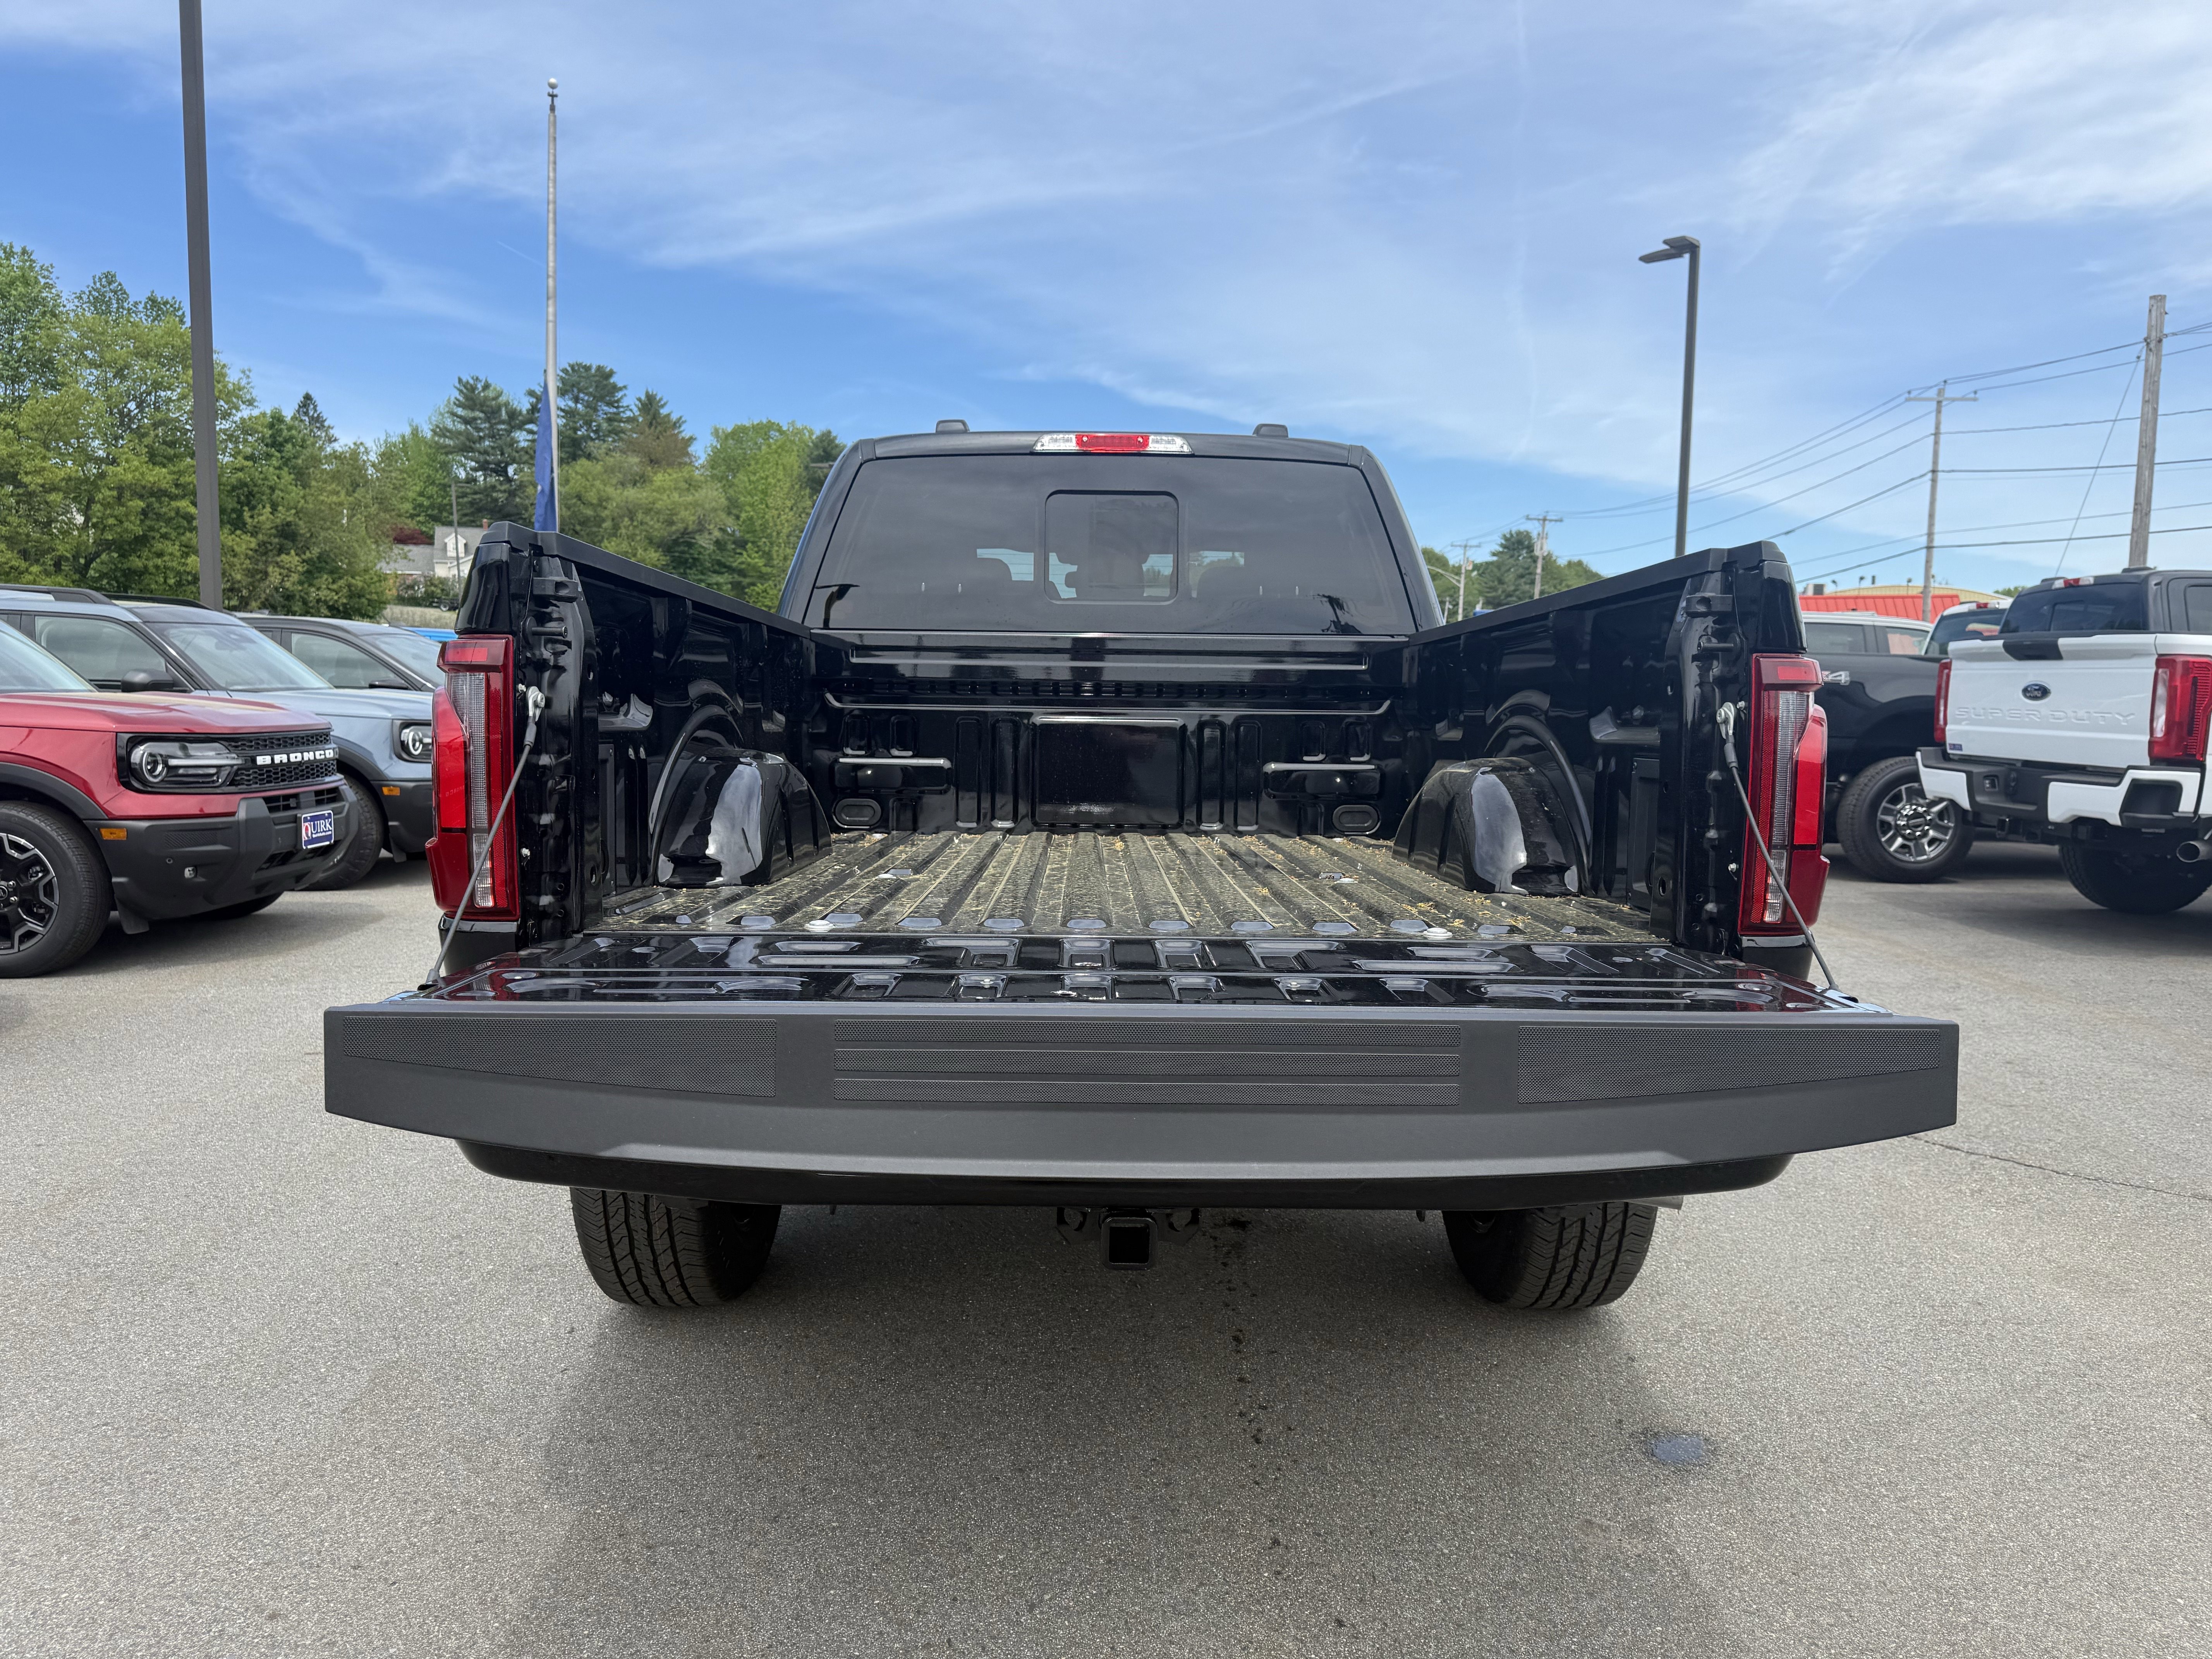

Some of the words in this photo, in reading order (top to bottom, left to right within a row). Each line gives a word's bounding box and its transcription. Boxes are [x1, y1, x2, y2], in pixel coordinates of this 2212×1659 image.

[1955, 707, 2041, 721] SUPER
[2049, 710, 2136, 725] DUTY
[256, 749, 334, 765] BRONCO
[303, 818, 332, 840] QUIRK
